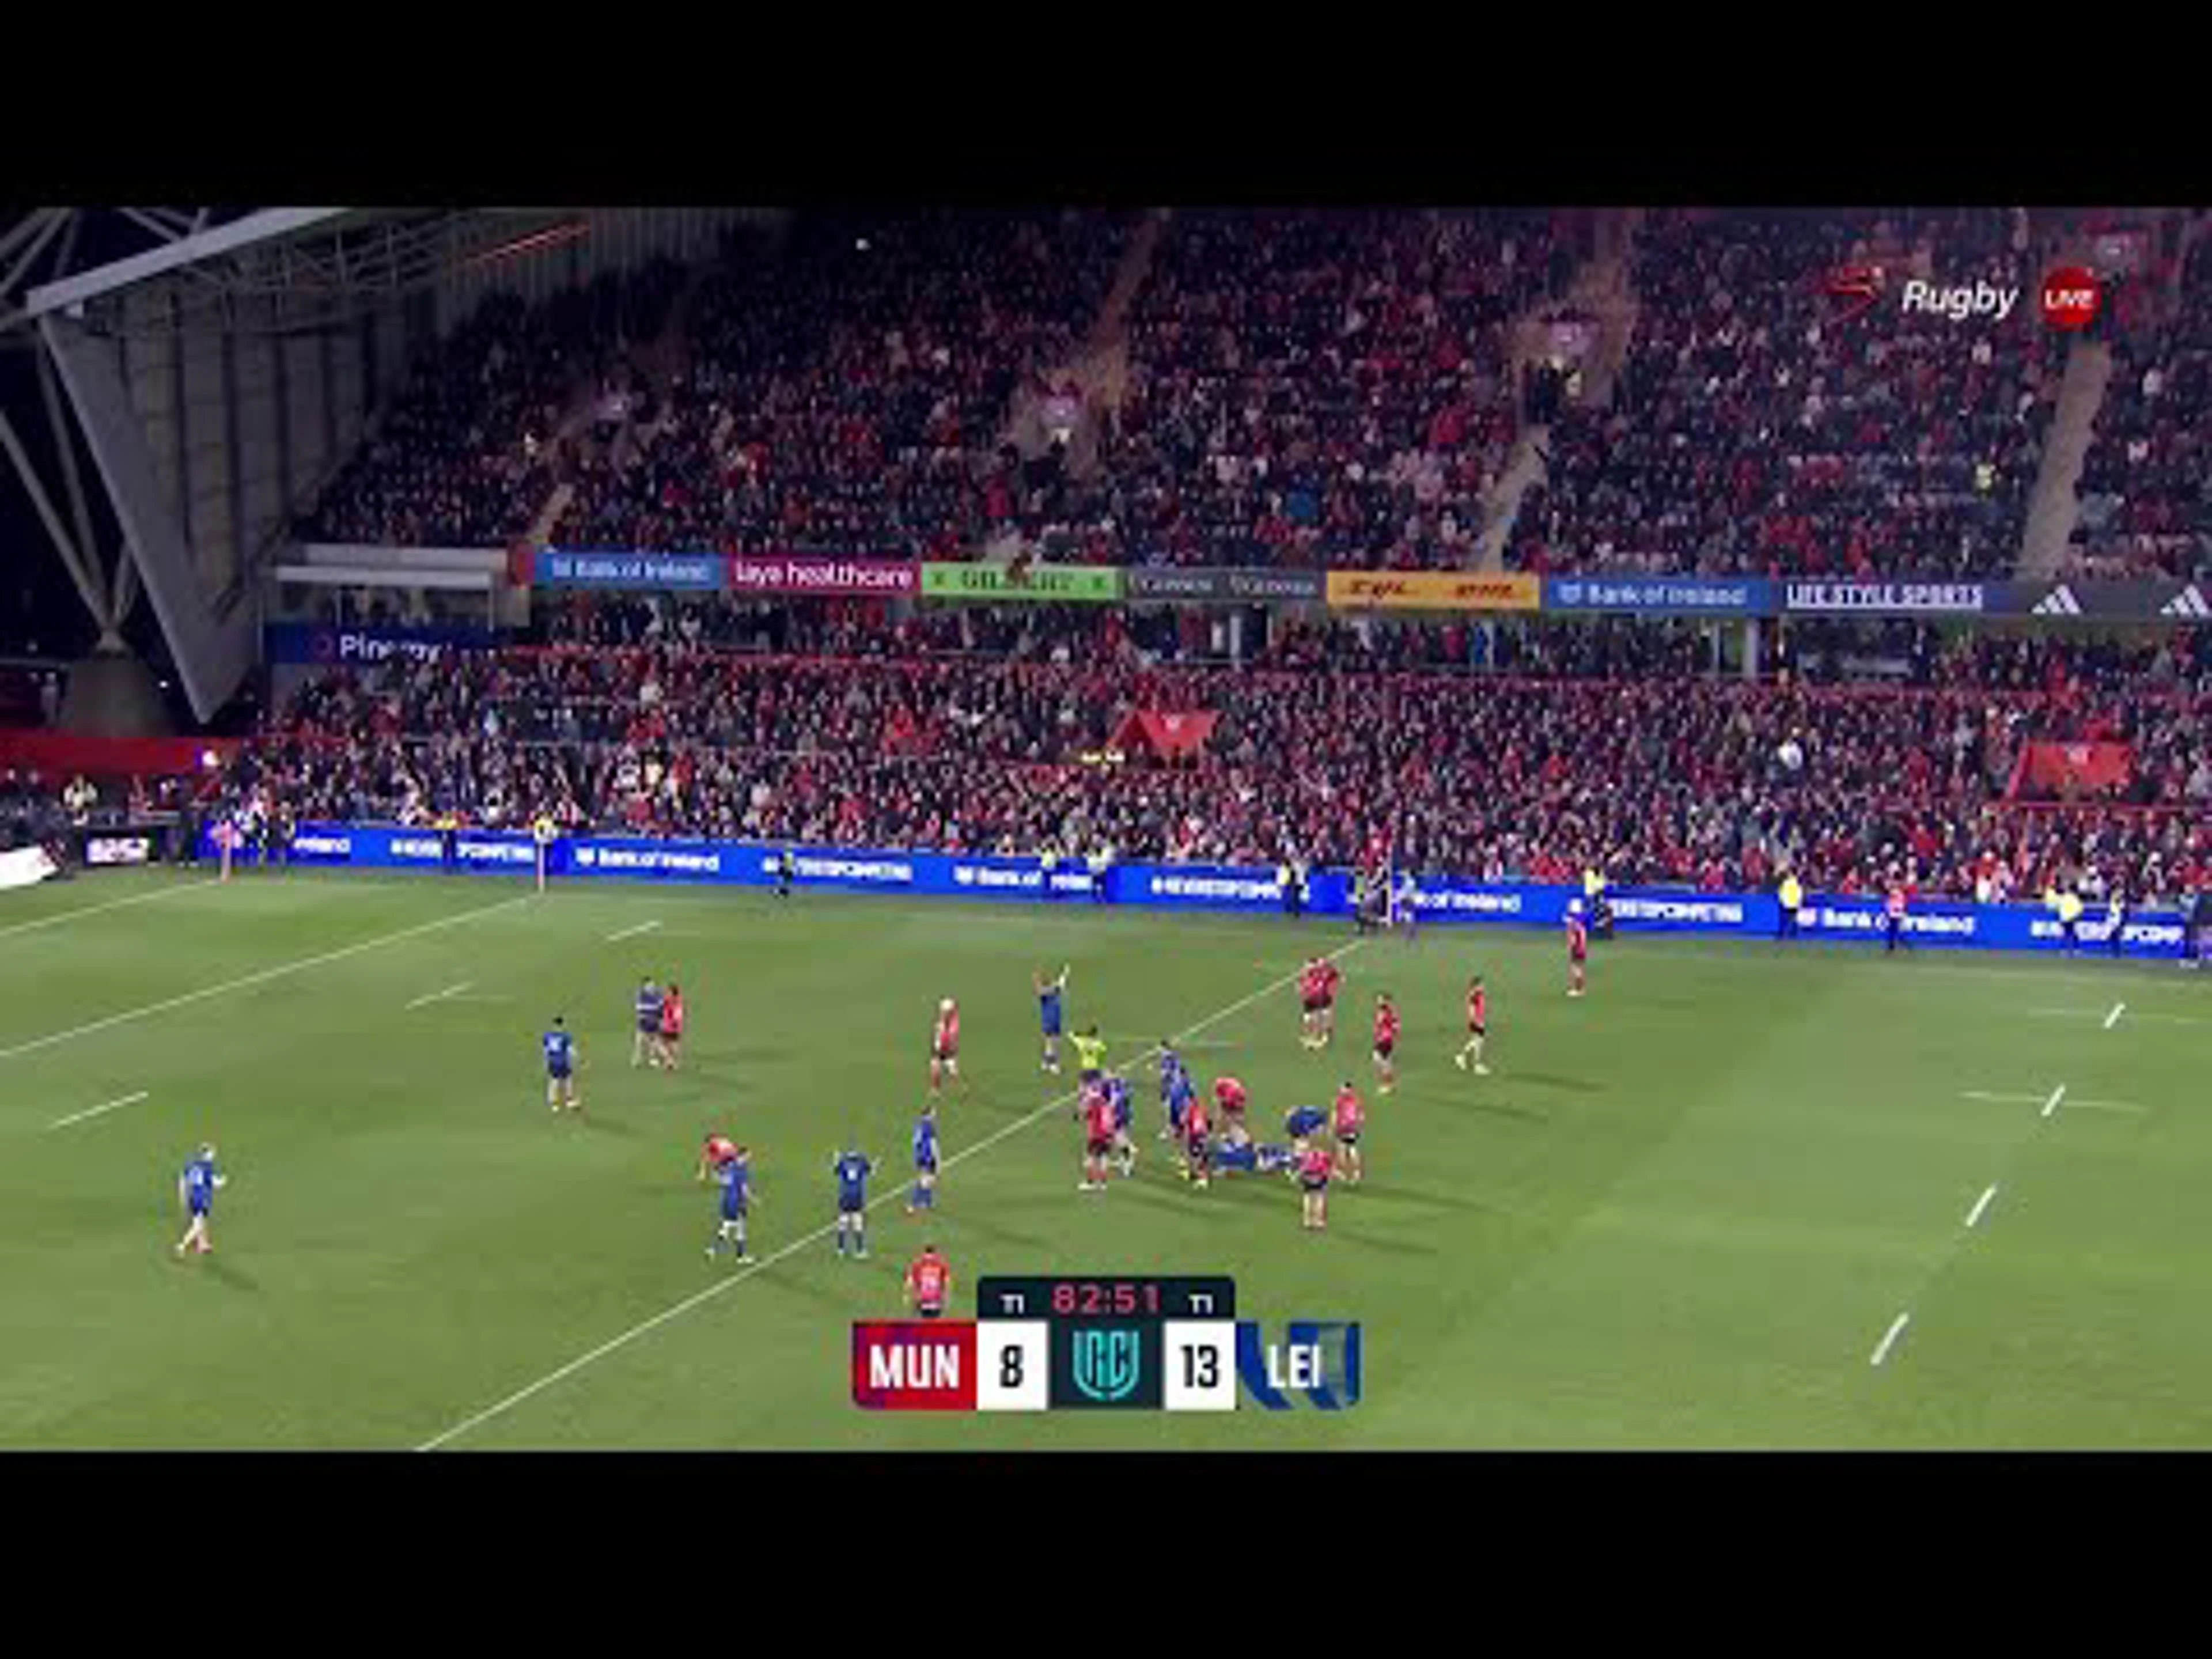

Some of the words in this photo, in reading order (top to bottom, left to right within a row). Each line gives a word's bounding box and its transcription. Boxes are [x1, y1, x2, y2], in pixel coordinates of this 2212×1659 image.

[1589, 584, 1641, 605] Bank
[1643, 584, 1665, 605] of
[1668, 584, 1749, 605] Ireland
[1787, 584, 1831, 605] LIFE
[1833, 584, 1900, 606] STYLE
[1903, 584, 1983, 607] SPORTS
